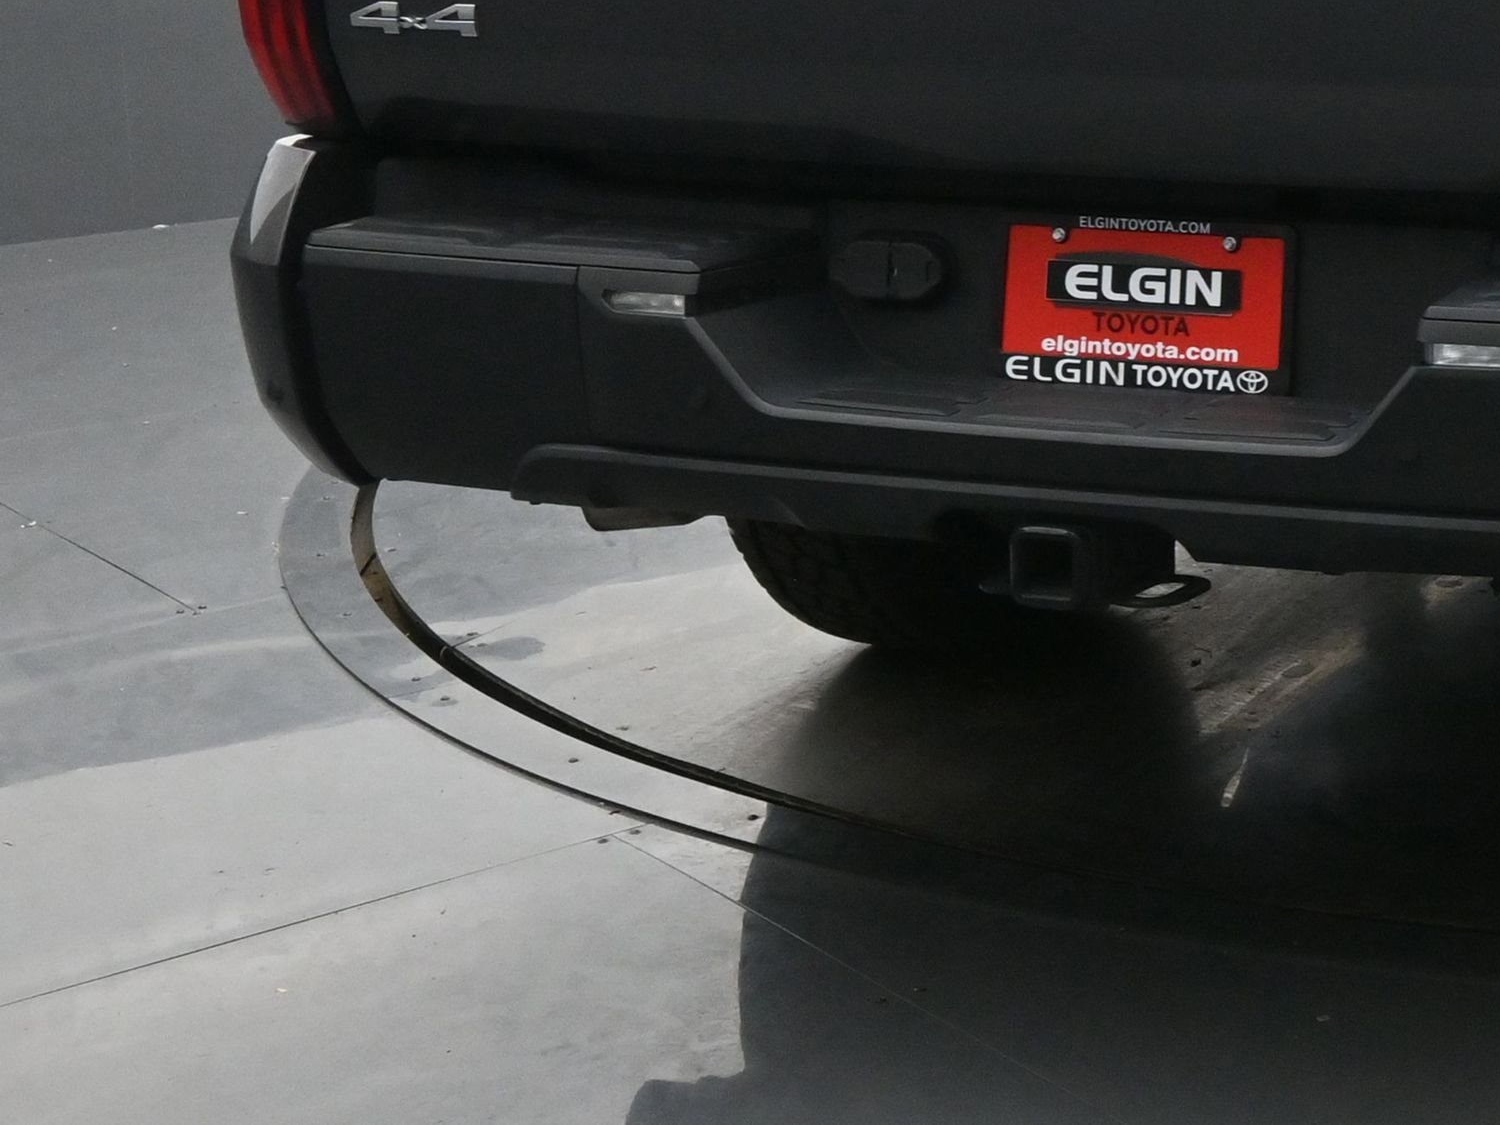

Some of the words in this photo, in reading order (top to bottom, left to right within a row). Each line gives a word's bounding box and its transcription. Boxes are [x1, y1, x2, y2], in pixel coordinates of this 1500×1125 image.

[1079, 216, 1211, 235] ELGINTOYOTA.COM
[1064, 263, 1222, 307] ELGIN
[1092, 311, 1190, 337] TOYOTA
[1040, 334, 1239, 363] elgintoyota.com
[1005, 355, 1125, 386] ELGIN
[1132, 364, 1235, 392] TOYOTA
